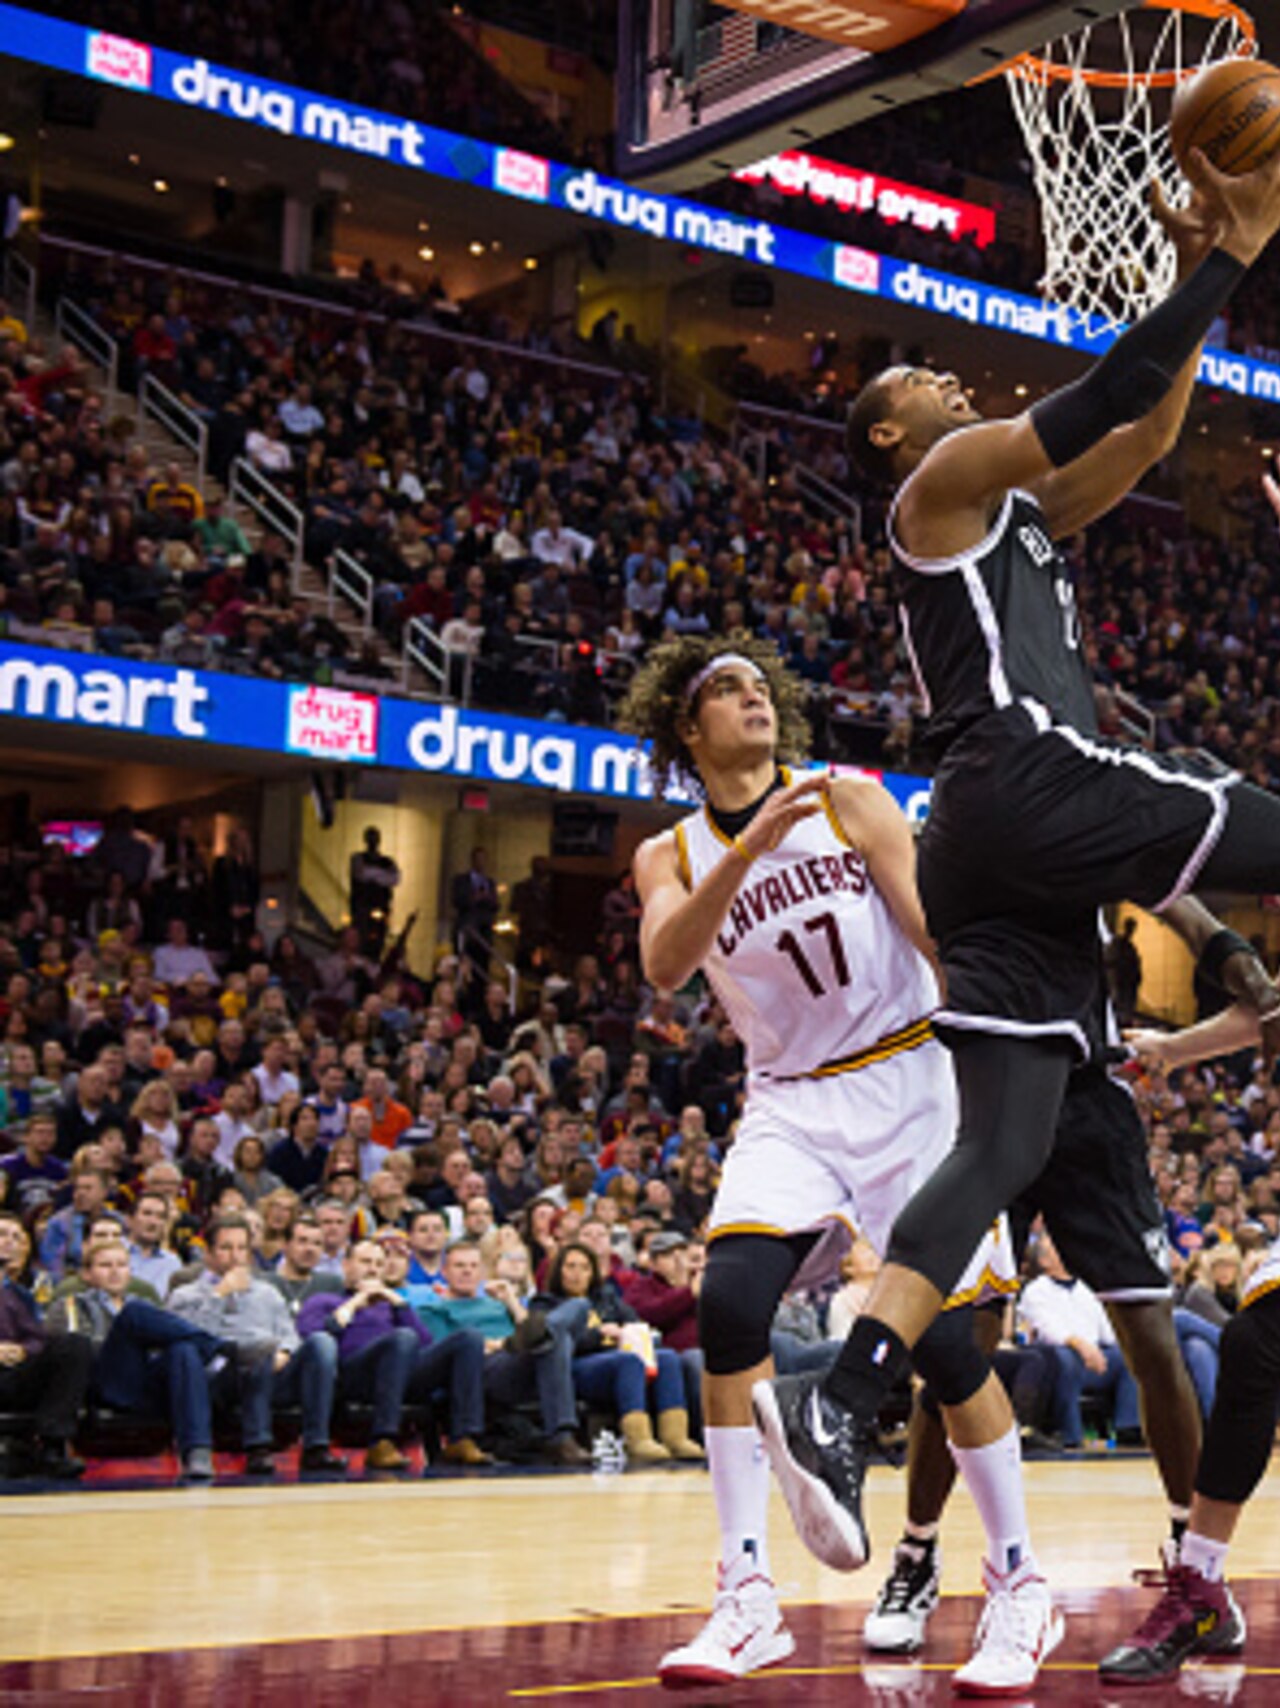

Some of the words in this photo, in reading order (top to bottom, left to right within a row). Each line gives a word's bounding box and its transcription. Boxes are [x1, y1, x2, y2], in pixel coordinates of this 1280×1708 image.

[172, 58, 294, 134] drug
[302, 102, 424, 165] mart
[564, 171, 667, 237] drug
[673, 208, 775, 263] mart
[892, 264, 978, 322] drug
[985, 297, 1071, 344] mart
[1195, 353, 1247, 395] rug
[0, 659, 208, 737] mart
[294, 684, 362, 732] drug
[407, 706, 576, 791] drug
[775, 911, 850, 998] 17
